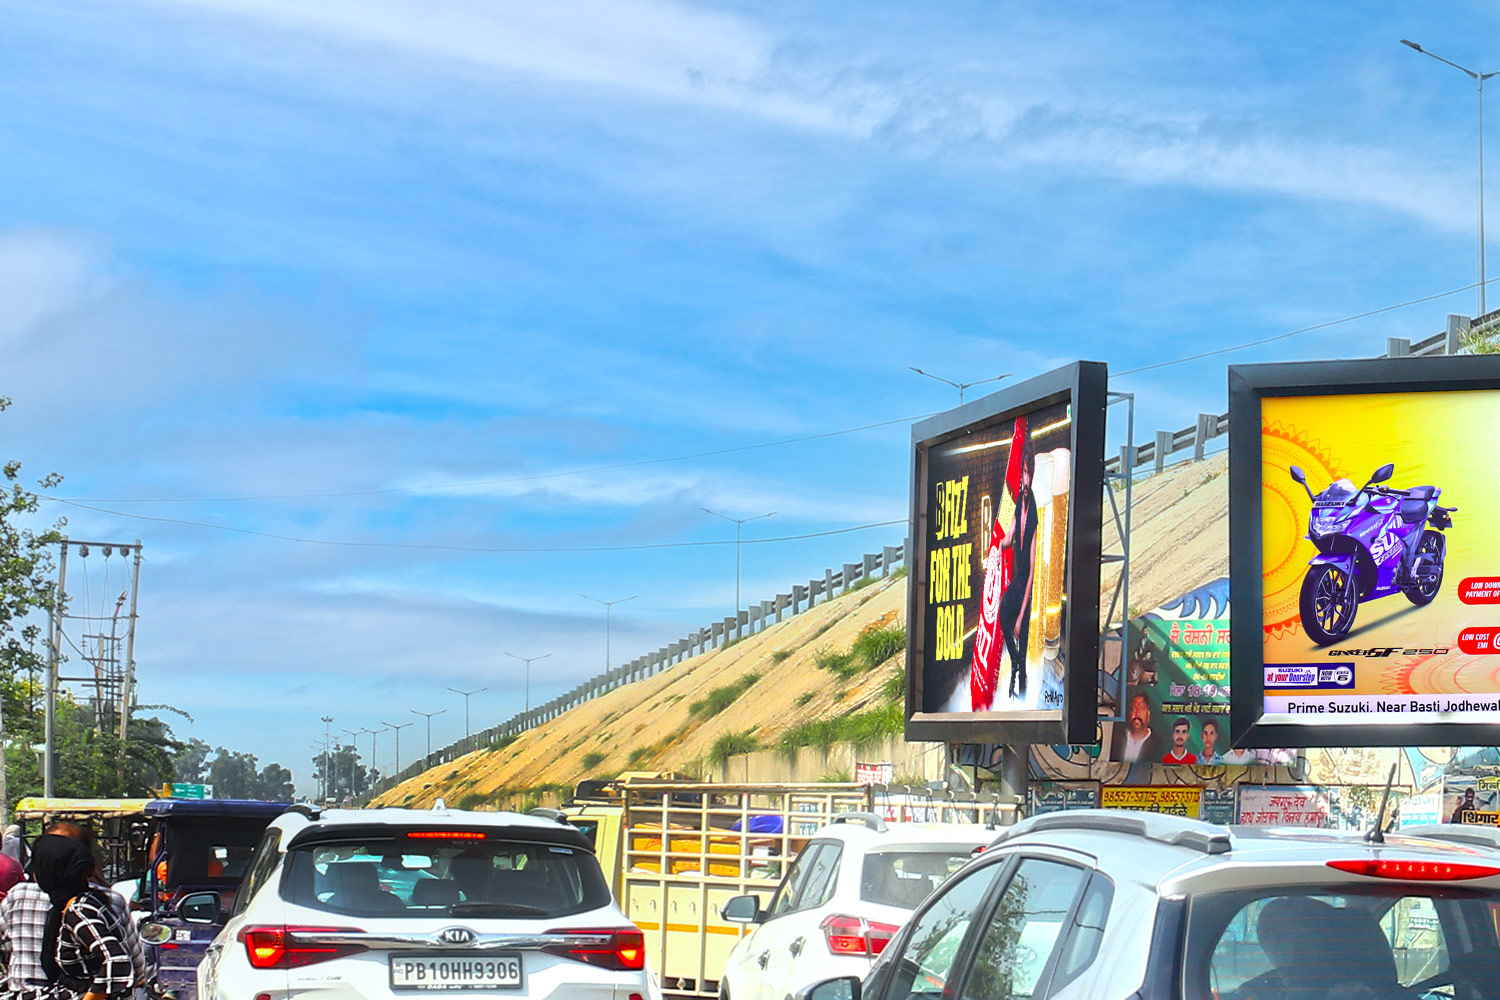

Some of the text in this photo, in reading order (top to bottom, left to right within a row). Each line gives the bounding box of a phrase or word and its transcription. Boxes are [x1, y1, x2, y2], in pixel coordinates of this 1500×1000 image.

[944, 475, 969, 539] FIZZ
[929, 547, 950, 604] FOR
[951, 542, 972, 600] THE
[1471, 582, 1484, 590] LOW
[1465, 590, 1492, 598] PAYMENT
[935, 603, 964, 661] BOLD
[1462, 633, 1490, 641] LOW COST
[1477, 641, 1489, 649] EMI
[1273, 673, 1289, 683] your
[1288, 671, 1316, 683] Doorstep
[1288, 702, 1325, 714] Prime
[1376, 701, 1407, 713] Near
[1410, 701, 1440, 712] Basti
[444, 930, 470, 941] KIA
[405, 961, 518, 980] PB10HH9306
